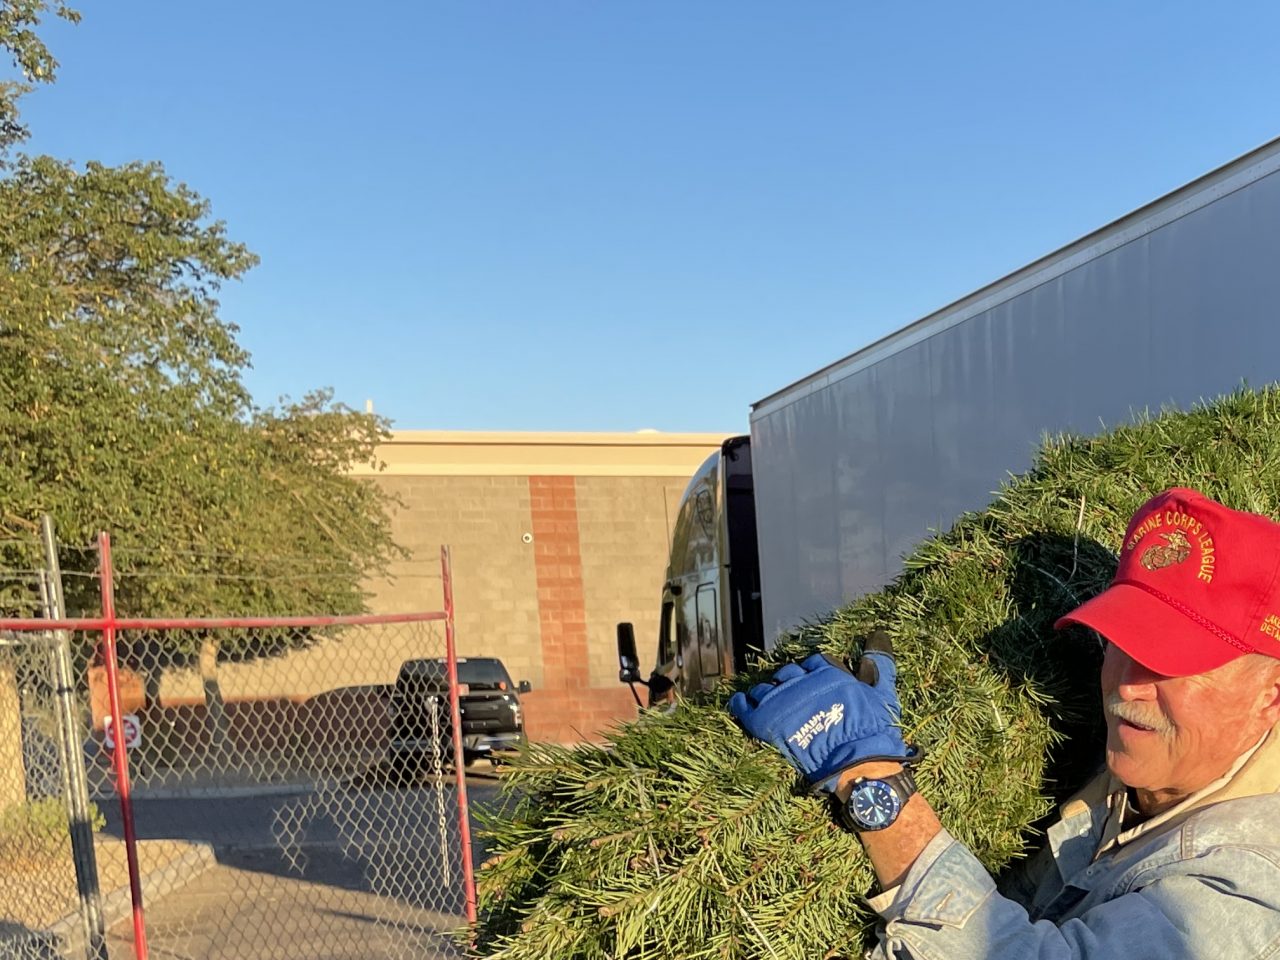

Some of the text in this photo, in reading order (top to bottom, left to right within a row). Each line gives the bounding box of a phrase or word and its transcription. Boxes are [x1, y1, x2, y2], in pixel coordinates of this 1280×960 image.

[1166, 511, 1202, 535] CORPS
[1198, 532, 1216, 584] LEAGUE
[798, 723, 825, 750] BLUE
